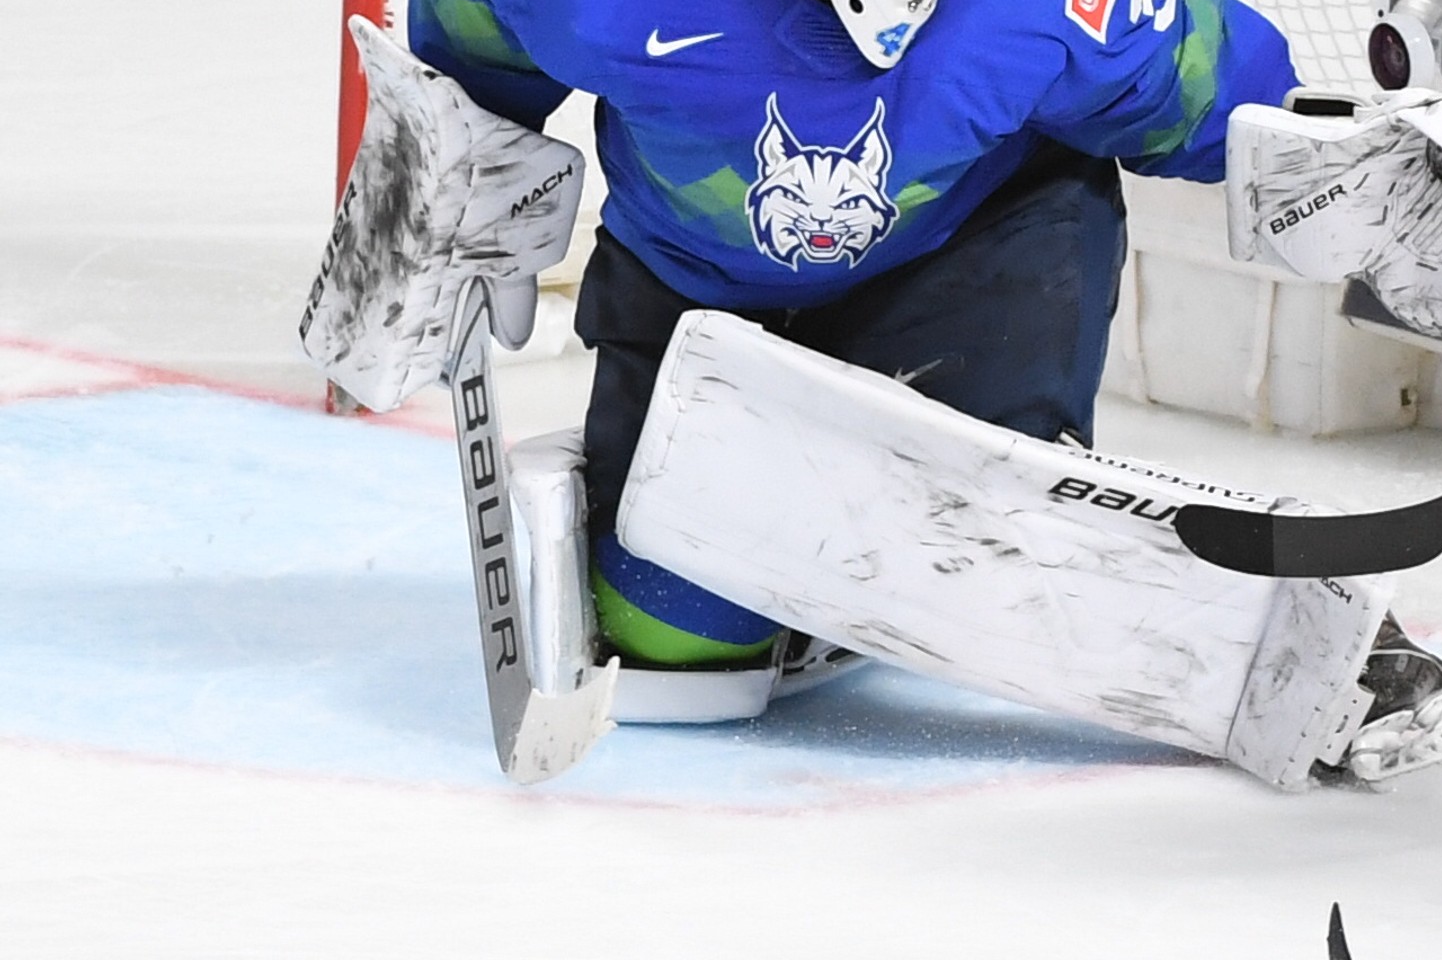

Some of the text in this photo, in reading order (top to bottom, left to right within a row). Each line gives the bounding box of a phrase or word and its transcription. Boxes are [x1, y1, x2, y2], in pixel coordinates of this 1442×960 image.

[509, 162, 574, 220] MACH
[1269, 183, 1346, 236] BAUER
[459, 374, 519, 672] BAUER
[1049, 476, 1182, 526] BAU
[1319, 575, 1353, 605] ACH
